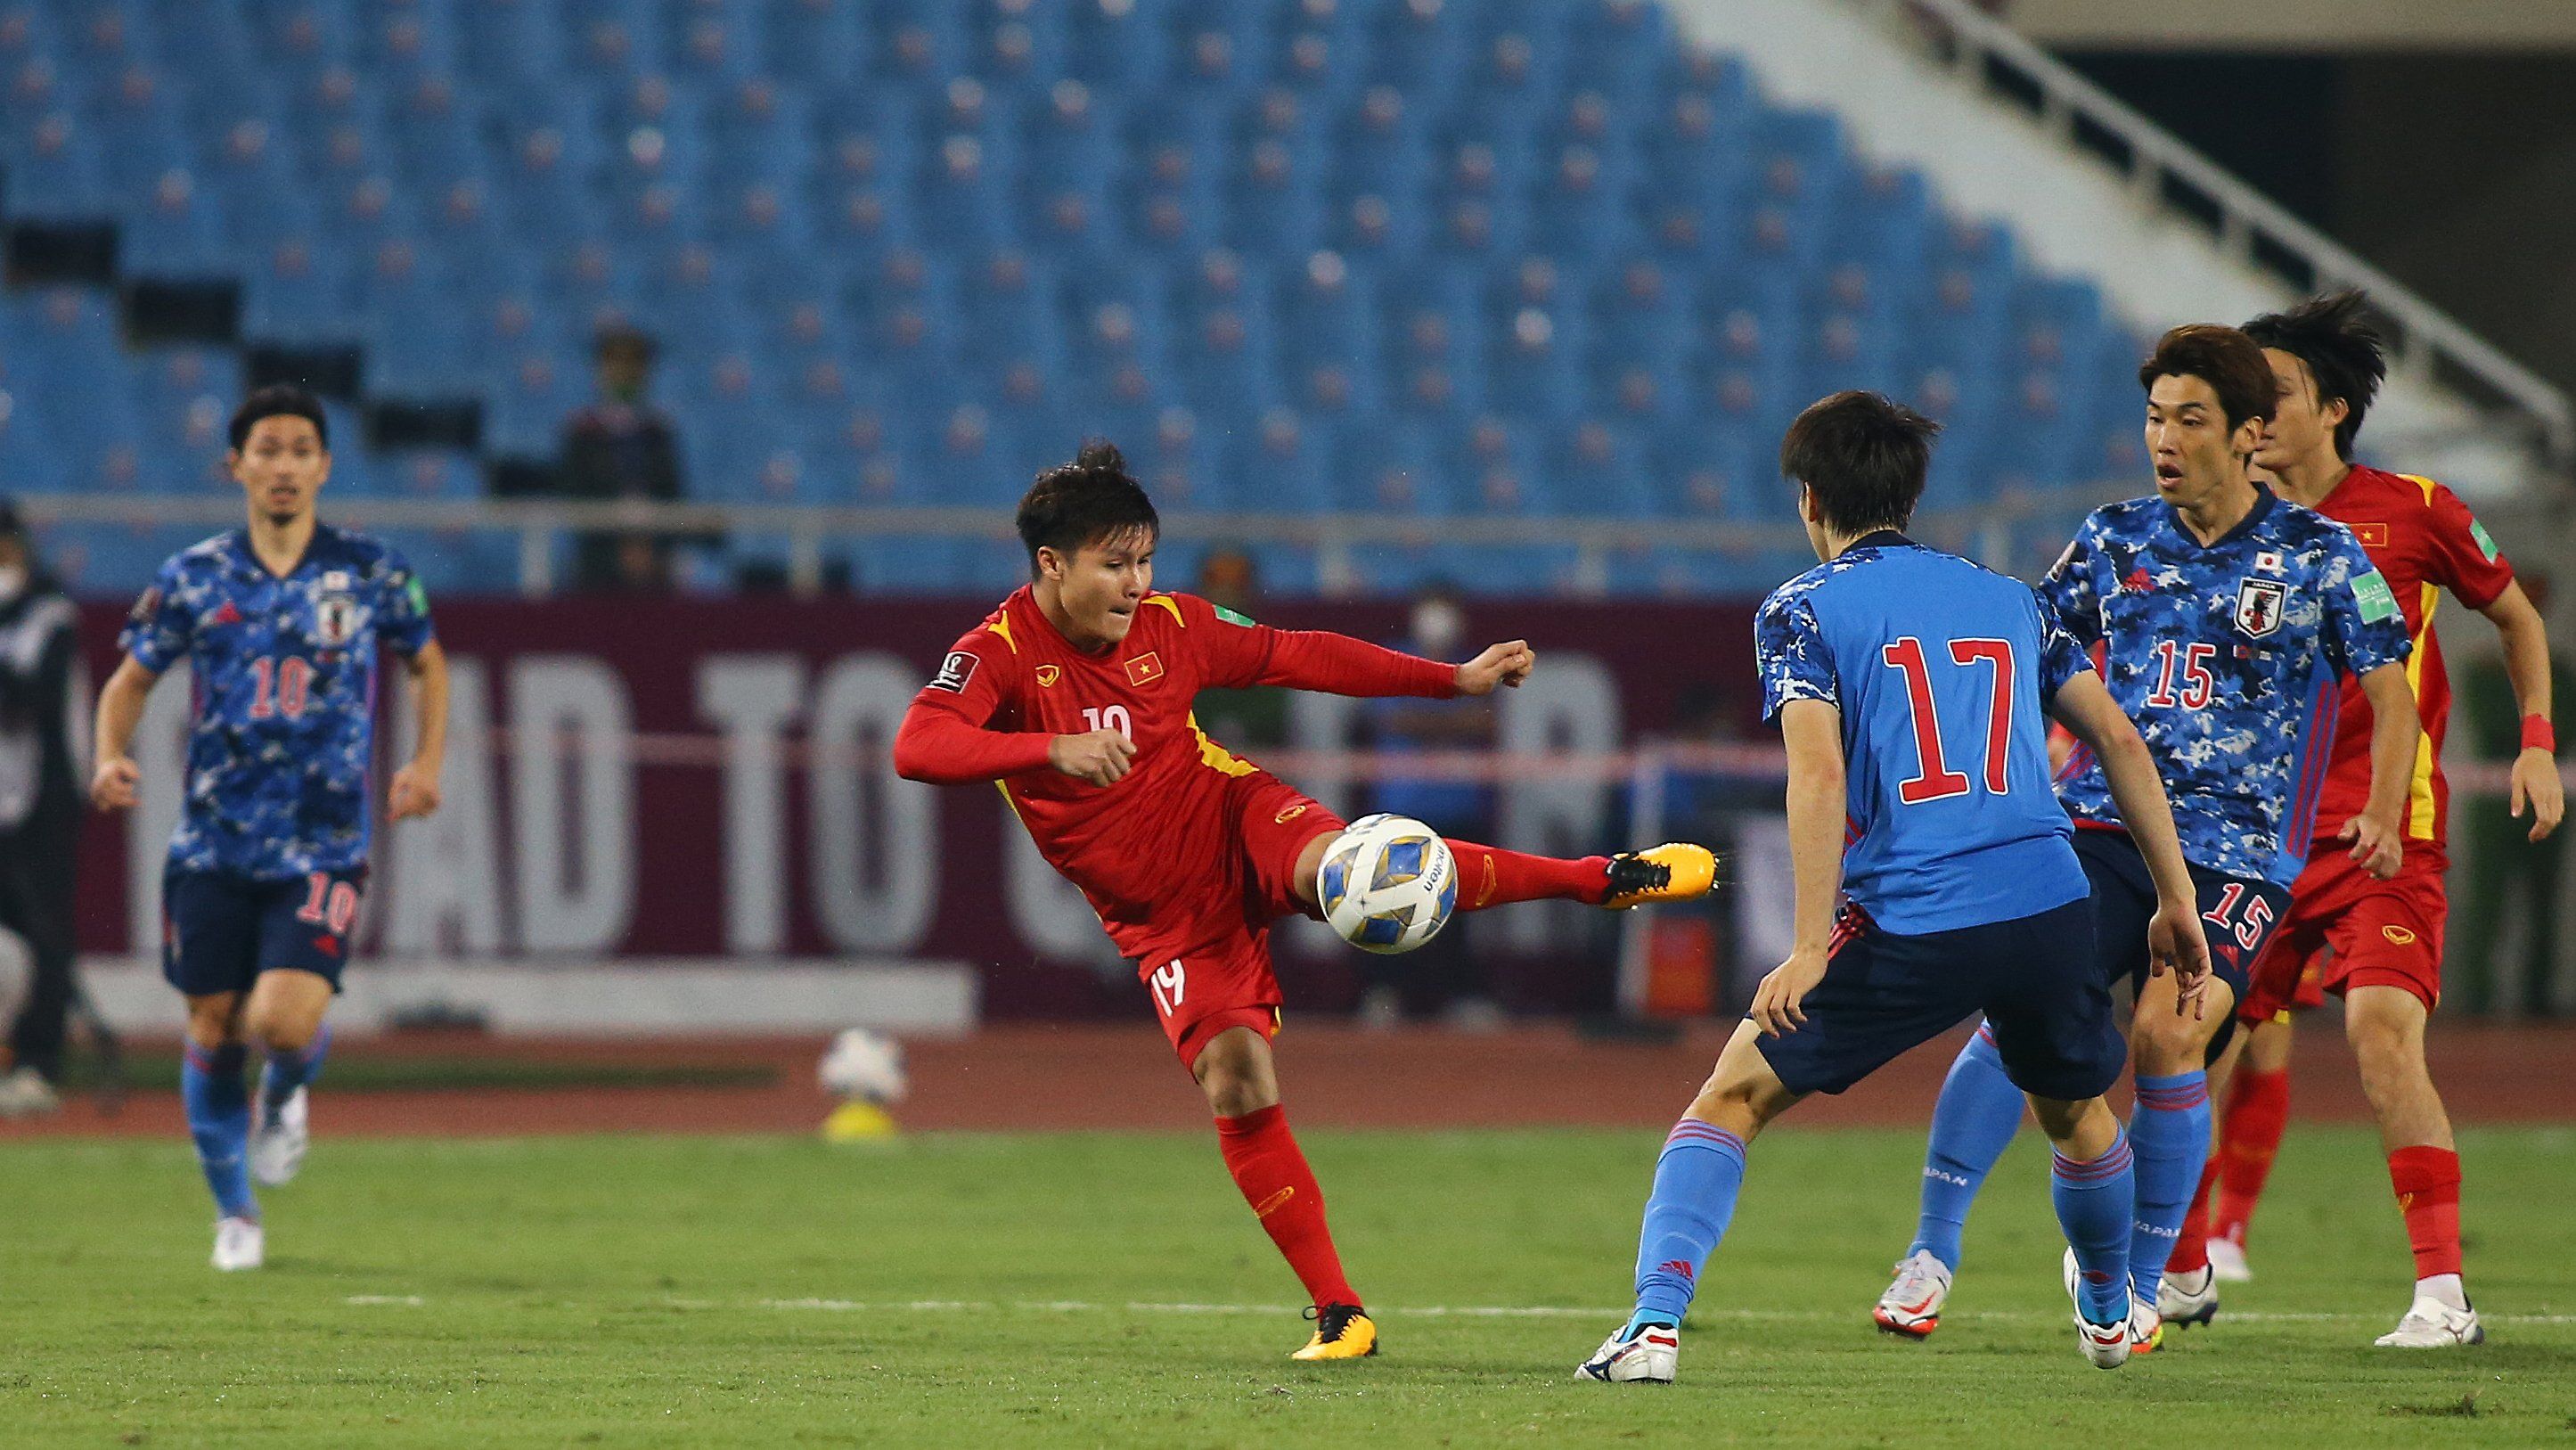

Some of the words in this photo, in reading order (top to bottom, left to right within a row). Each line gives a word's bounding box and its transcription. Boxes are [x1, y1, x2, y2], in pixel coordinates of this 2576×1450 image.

[246, 655, 314, 722] 10
[2147, 640, 2216, 710] 15
[1882, 635, 2016, 806] 17
[698, 649, 937, 955] TO
[1423, 844, 1445, 892] molten
[296, 871, 357, 936] 10
[2202, 882, 2273, 951] 15
[1923, 1167, 1967, 1187] APAN
